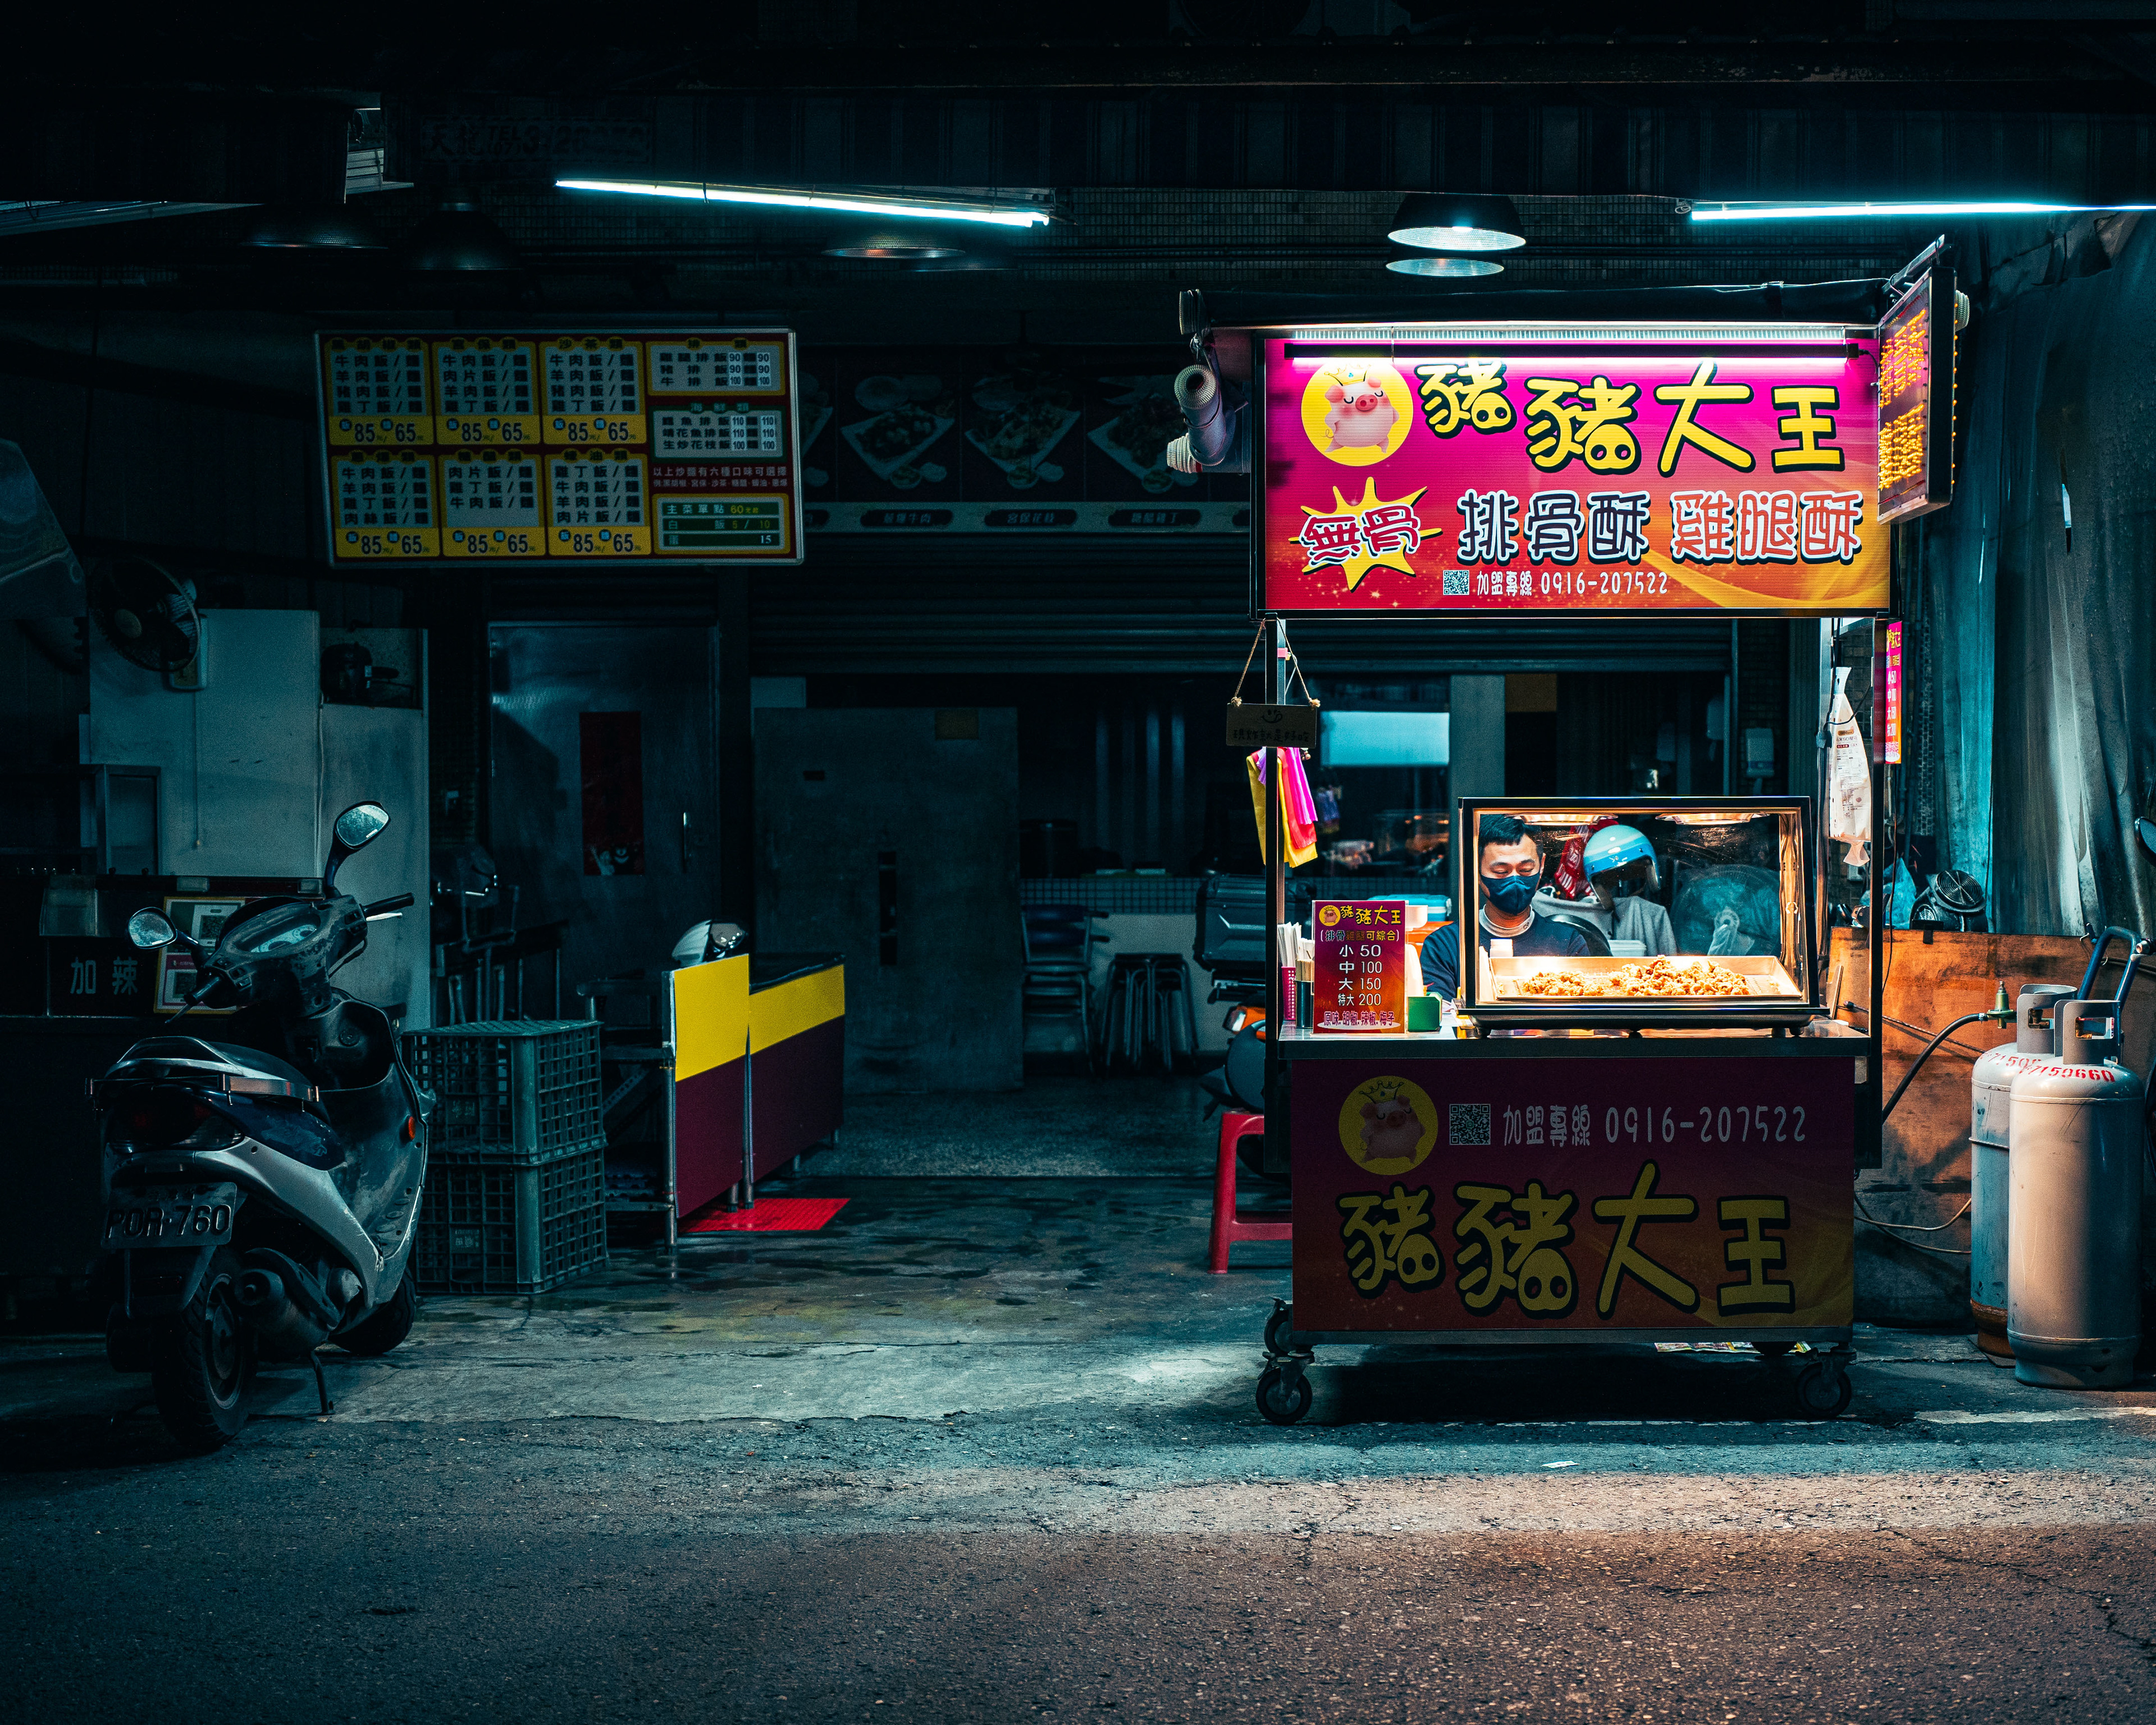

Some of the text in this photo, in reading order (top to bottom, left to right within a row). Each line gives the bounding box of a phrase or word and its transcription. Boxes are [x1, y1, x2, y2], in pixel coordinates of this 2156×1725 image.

[1415, 359, 1846, 477] 豬豬大王
[355, 423, 375, 442] 85
[395, 423, 416, 442] 65
[462, 422, 482, 441] 85
[502, 422, 522, 441] 65
[568, 422, 588, 441] 85
[608, 422, 628, 441] 65
[1299, 501, 1422, 568] 無骨
[1458, 489, 1865, 566] 排骨酥 雞腿酥
[362, 535, 381, 554] 85
[401, 535, 422, 554] 65
[468, 535, 488, 553] 85
[508, 535, 528, 553] 65
[573, 533, 593, 553] 85
[613, 533, 633, 552] 65
[760, 535, 772, 544] 15
[1476, 572, 1669, 597] 加盟專線 0916-207522
[1233, 728, 1309, 742] 現炸就是好吃
[1340, 905, 1401, 925] 豬豬大王
[1339, 944, 1381, 957] 小 50
[70, 957, 138, 995] 加辣
[1339, 961, 1382, 974] 中 100
[1338, 978, 1381, 991] 大 150
[1337, 993, 1381, 1006] 特大 200
[1502, 1104, 1806, 1147] 加盟專線 0916-207522
[1336, 1158, 1796, 1320] 豬豬大王
